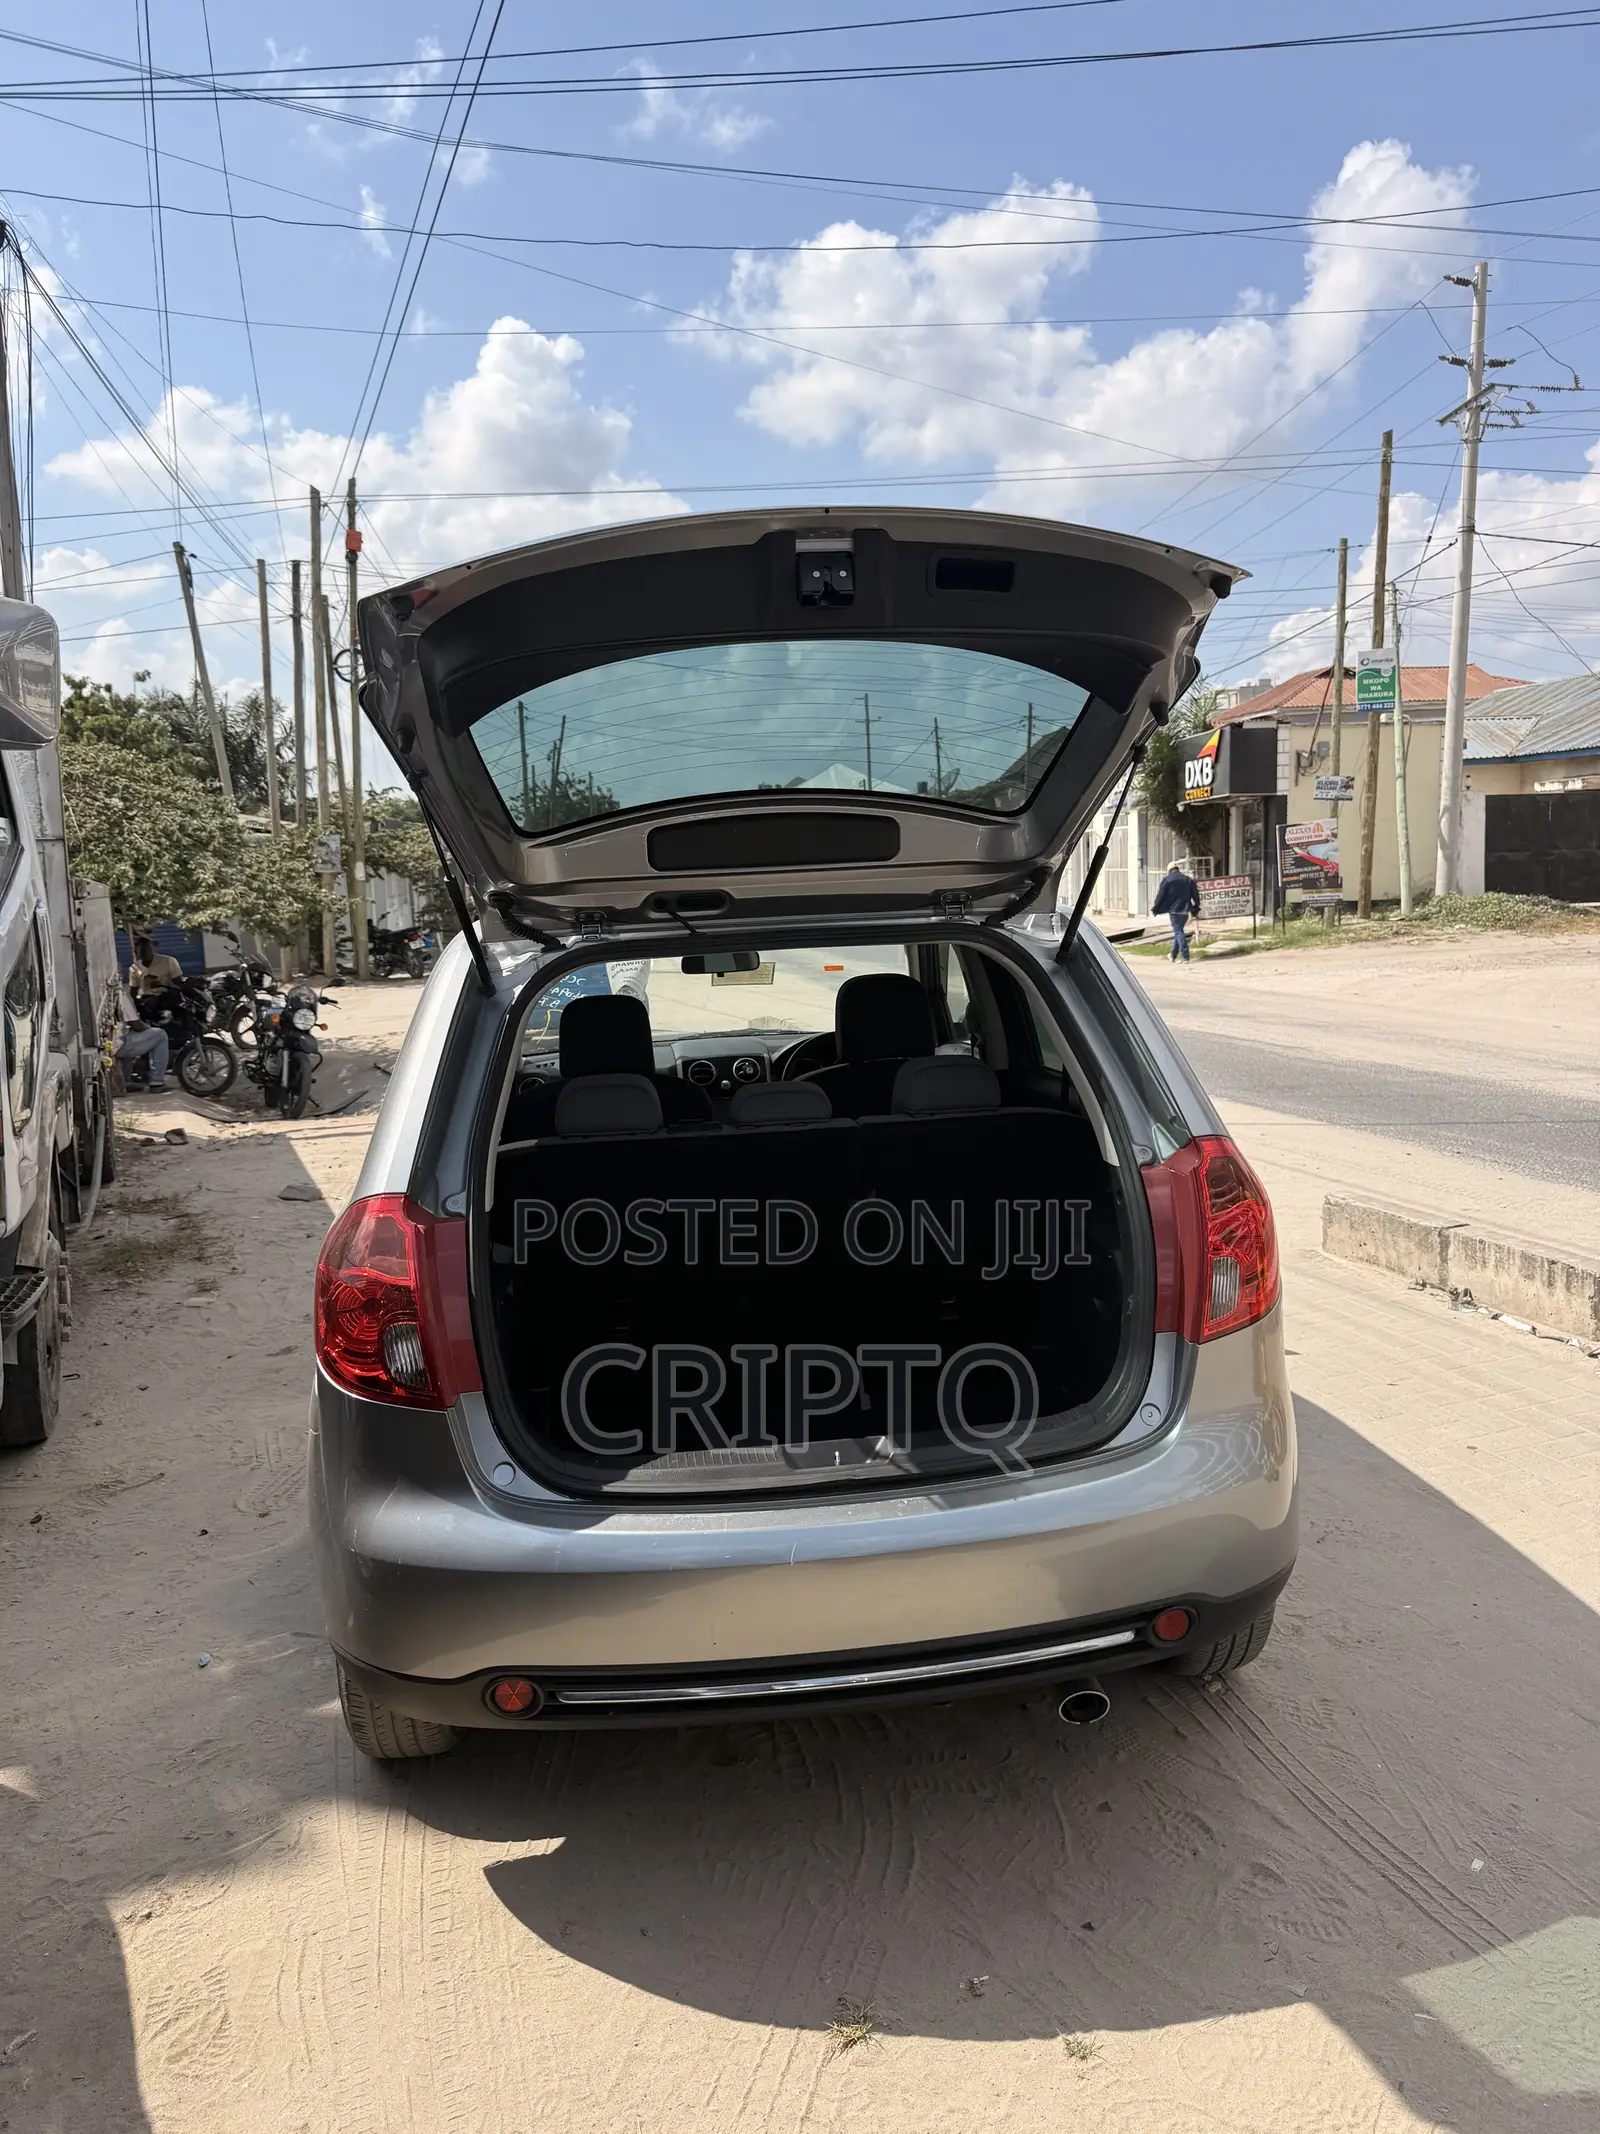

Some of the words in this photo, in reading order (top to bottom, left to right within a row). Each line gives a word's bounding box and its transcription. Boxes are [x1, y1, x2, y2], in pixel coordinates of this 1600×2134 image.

[1363, 677, 1390, 685] MKOPO
[1185, 757, 1213, 789] DXB
[1184, 786, 1212, 800] CONNECT
[1196, 880, 1213, 891] ST.
[1214, 876, 1251, 889] CLARA
[1199, 888, 1251, 901] DISPENSARY
